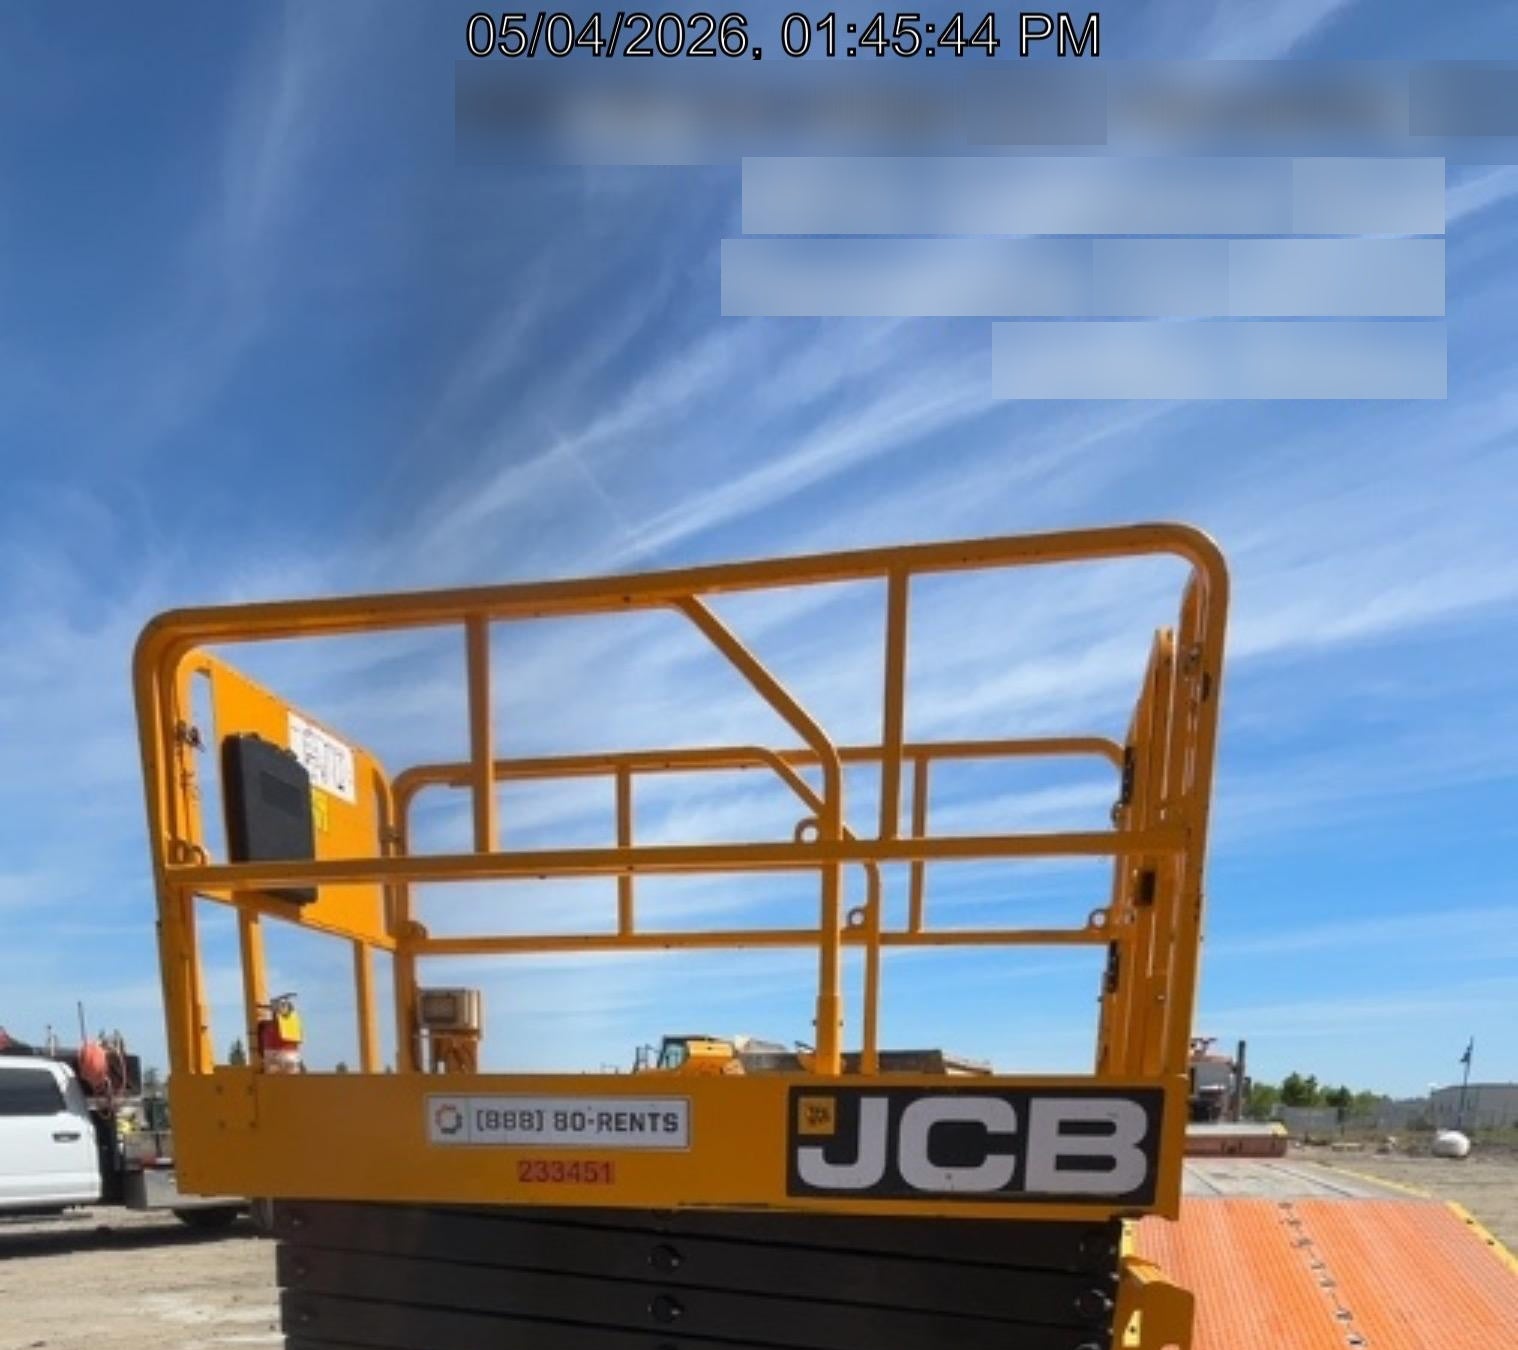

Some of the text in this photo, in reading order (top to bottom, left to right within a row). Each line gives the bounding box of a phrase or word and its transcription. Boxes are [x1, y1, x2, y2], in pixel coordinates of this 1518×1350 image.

[553, 1110, 680, 1133] 80-RENTS
[797, 1096, 1147, 1196] JCB
[516, 1160, 614, 1184] 233451
